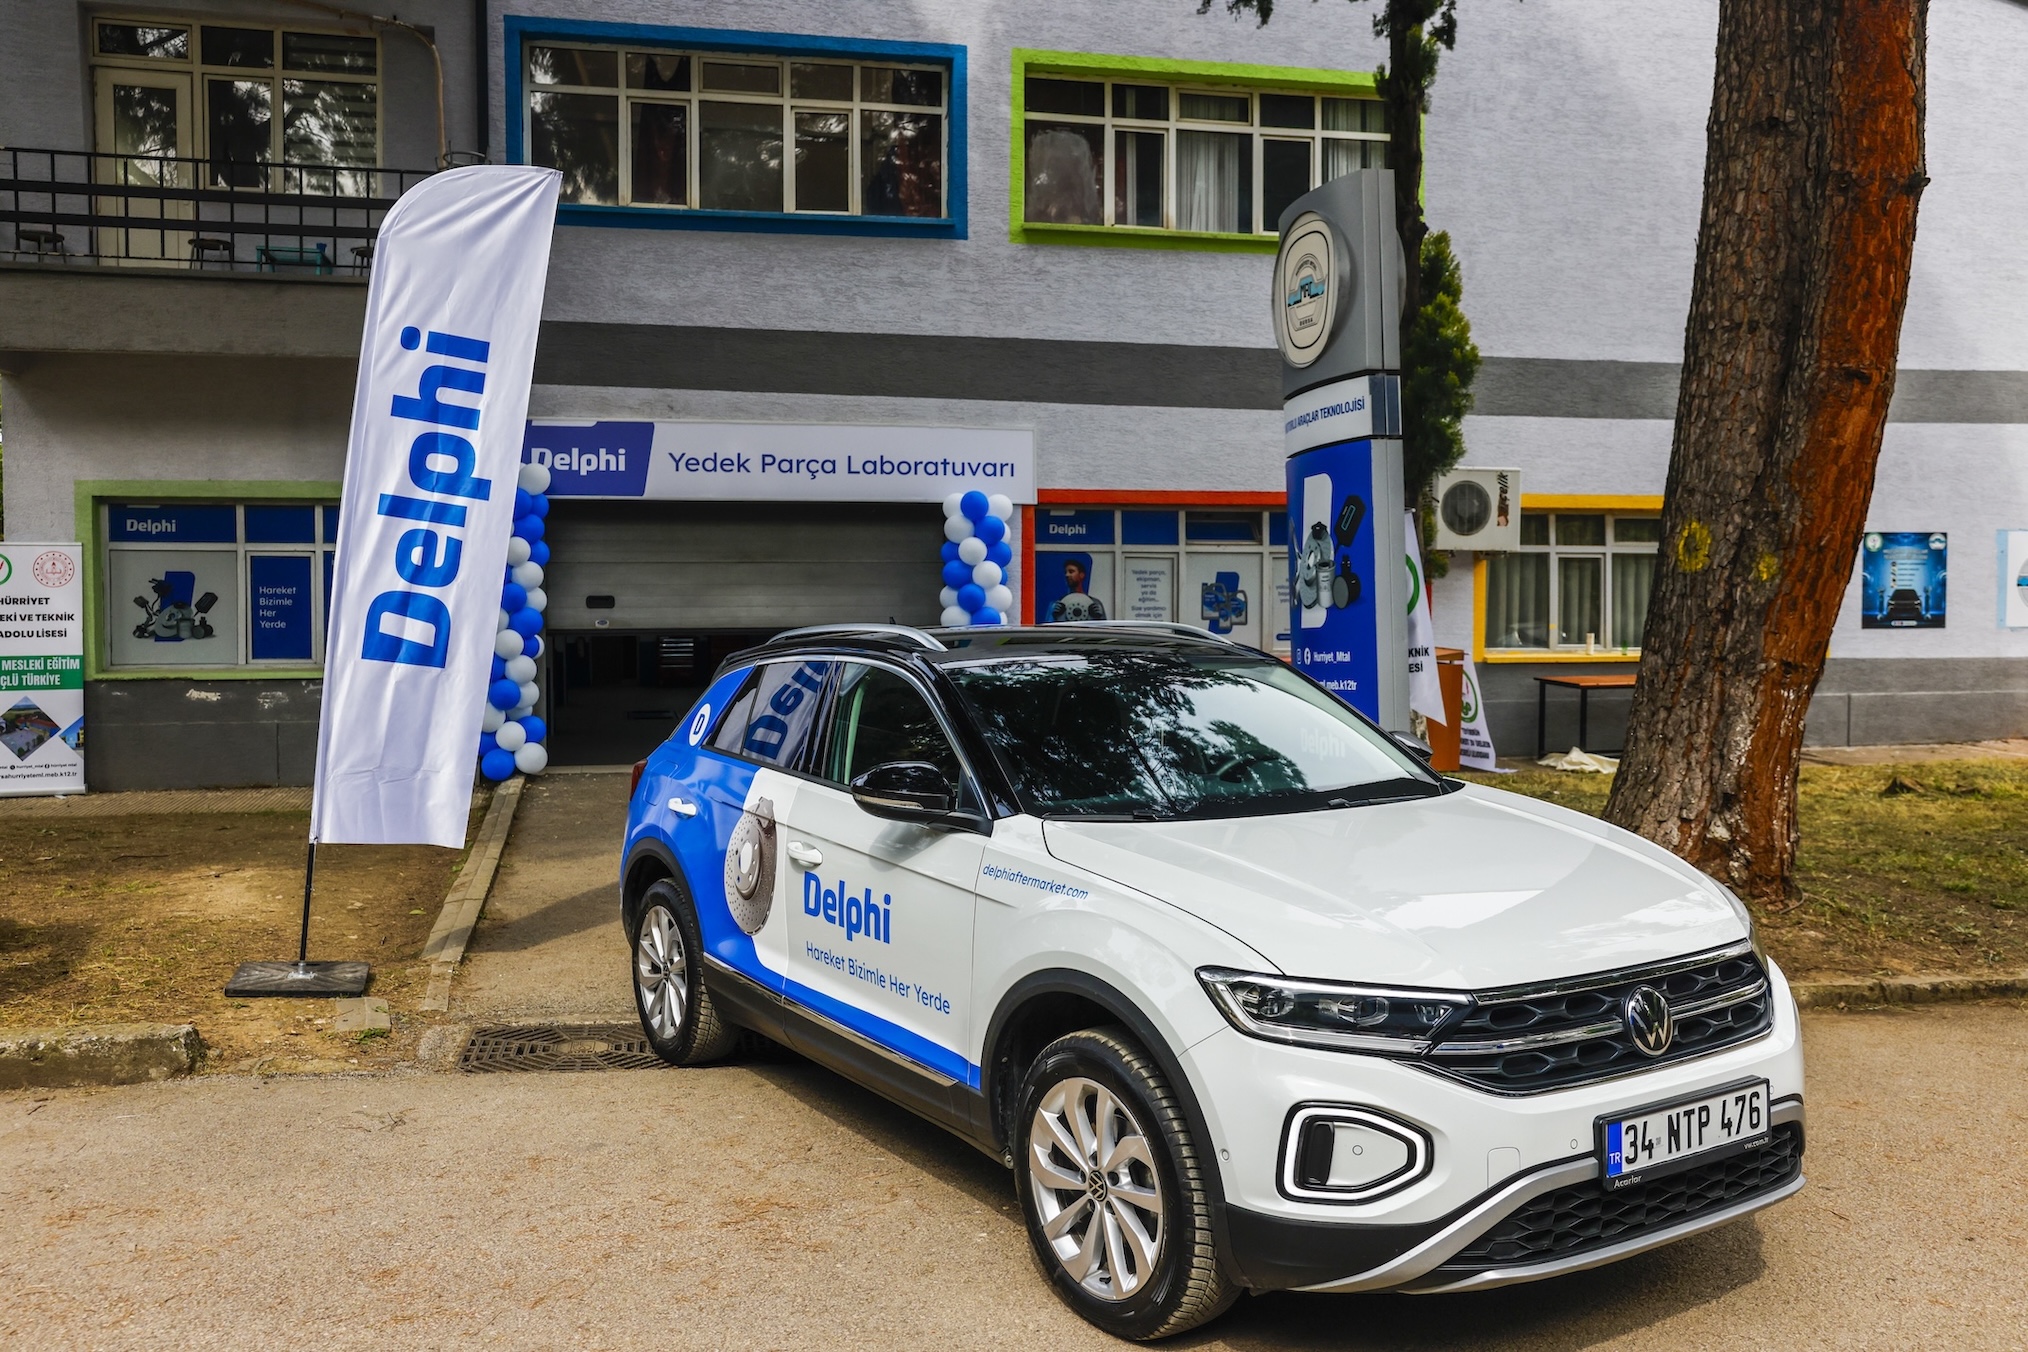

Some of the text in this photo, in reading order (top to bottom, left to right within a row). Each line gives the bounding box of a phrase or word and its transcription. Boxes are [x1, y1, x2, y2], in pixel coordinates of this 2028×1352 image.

[1320, 396, 1365, 419] TEKNOLOJİSİ
[531, 447, 627, 476] Delphi
[668, 452, 1015, 479] Yedek Parça Laboratuvarı
[361, 326, 492, 669] Delphi
[126, 518, 177, 535] Delphi
[1049, 524, 1087, 536] Delphi
[259, 586, 297, 595] Hareket
[259, 597, 293, 606] Bizimle
[19, 613, 34, 622] VE
[35, 612, 75, 622] TEKNİK
[259, 609, 276, 618] Her
[259, 620, 287, 629] Yerde
[36, 628, 67, 638] LİSESİ
[2, 656, 80, 671] MESLEKİ EĞİTİM
[21, 672, 61, 686] TÜRKİYE
[982, 864, 1090, 900] delphiaftermarket.com
[804, 871, 892, 944] Delphi
[806, 940, 951, 1015] Hareket Bizimle Her Yerde
[1624, 1090, 1760, 1165] 34 NTP 476
[1609, 1152, 1622, 1165] TR
[1613, 1174, 1642, 1189] Acarlar
